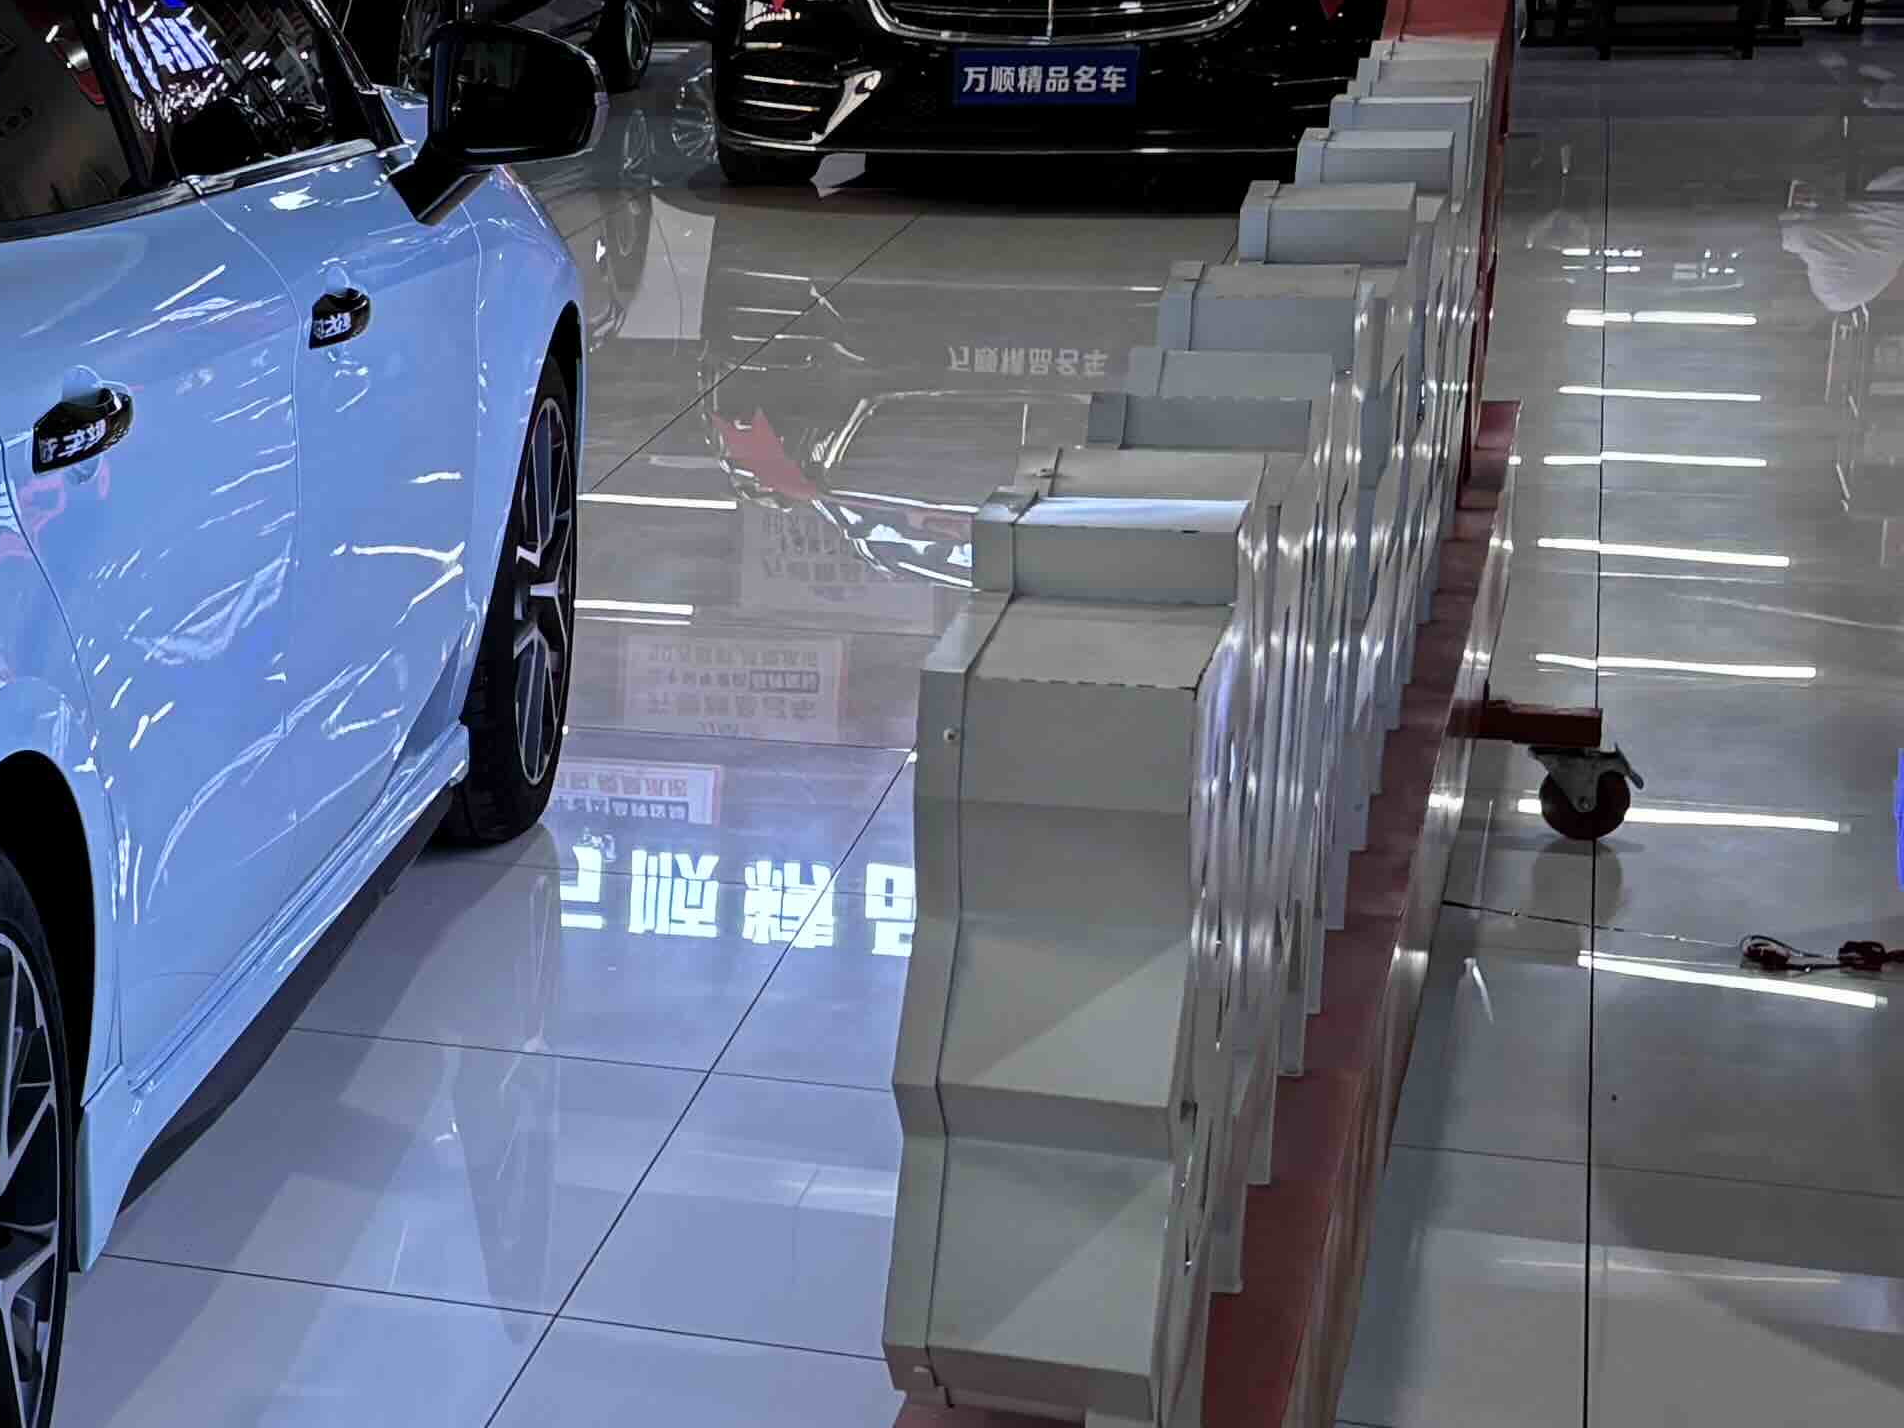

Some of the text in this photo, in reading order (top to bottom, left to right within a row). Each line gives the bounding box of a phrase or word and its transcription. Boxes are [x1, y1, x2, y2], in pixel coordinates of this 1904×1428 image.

[962, 65, 1127, 93] 万顺精品名车
